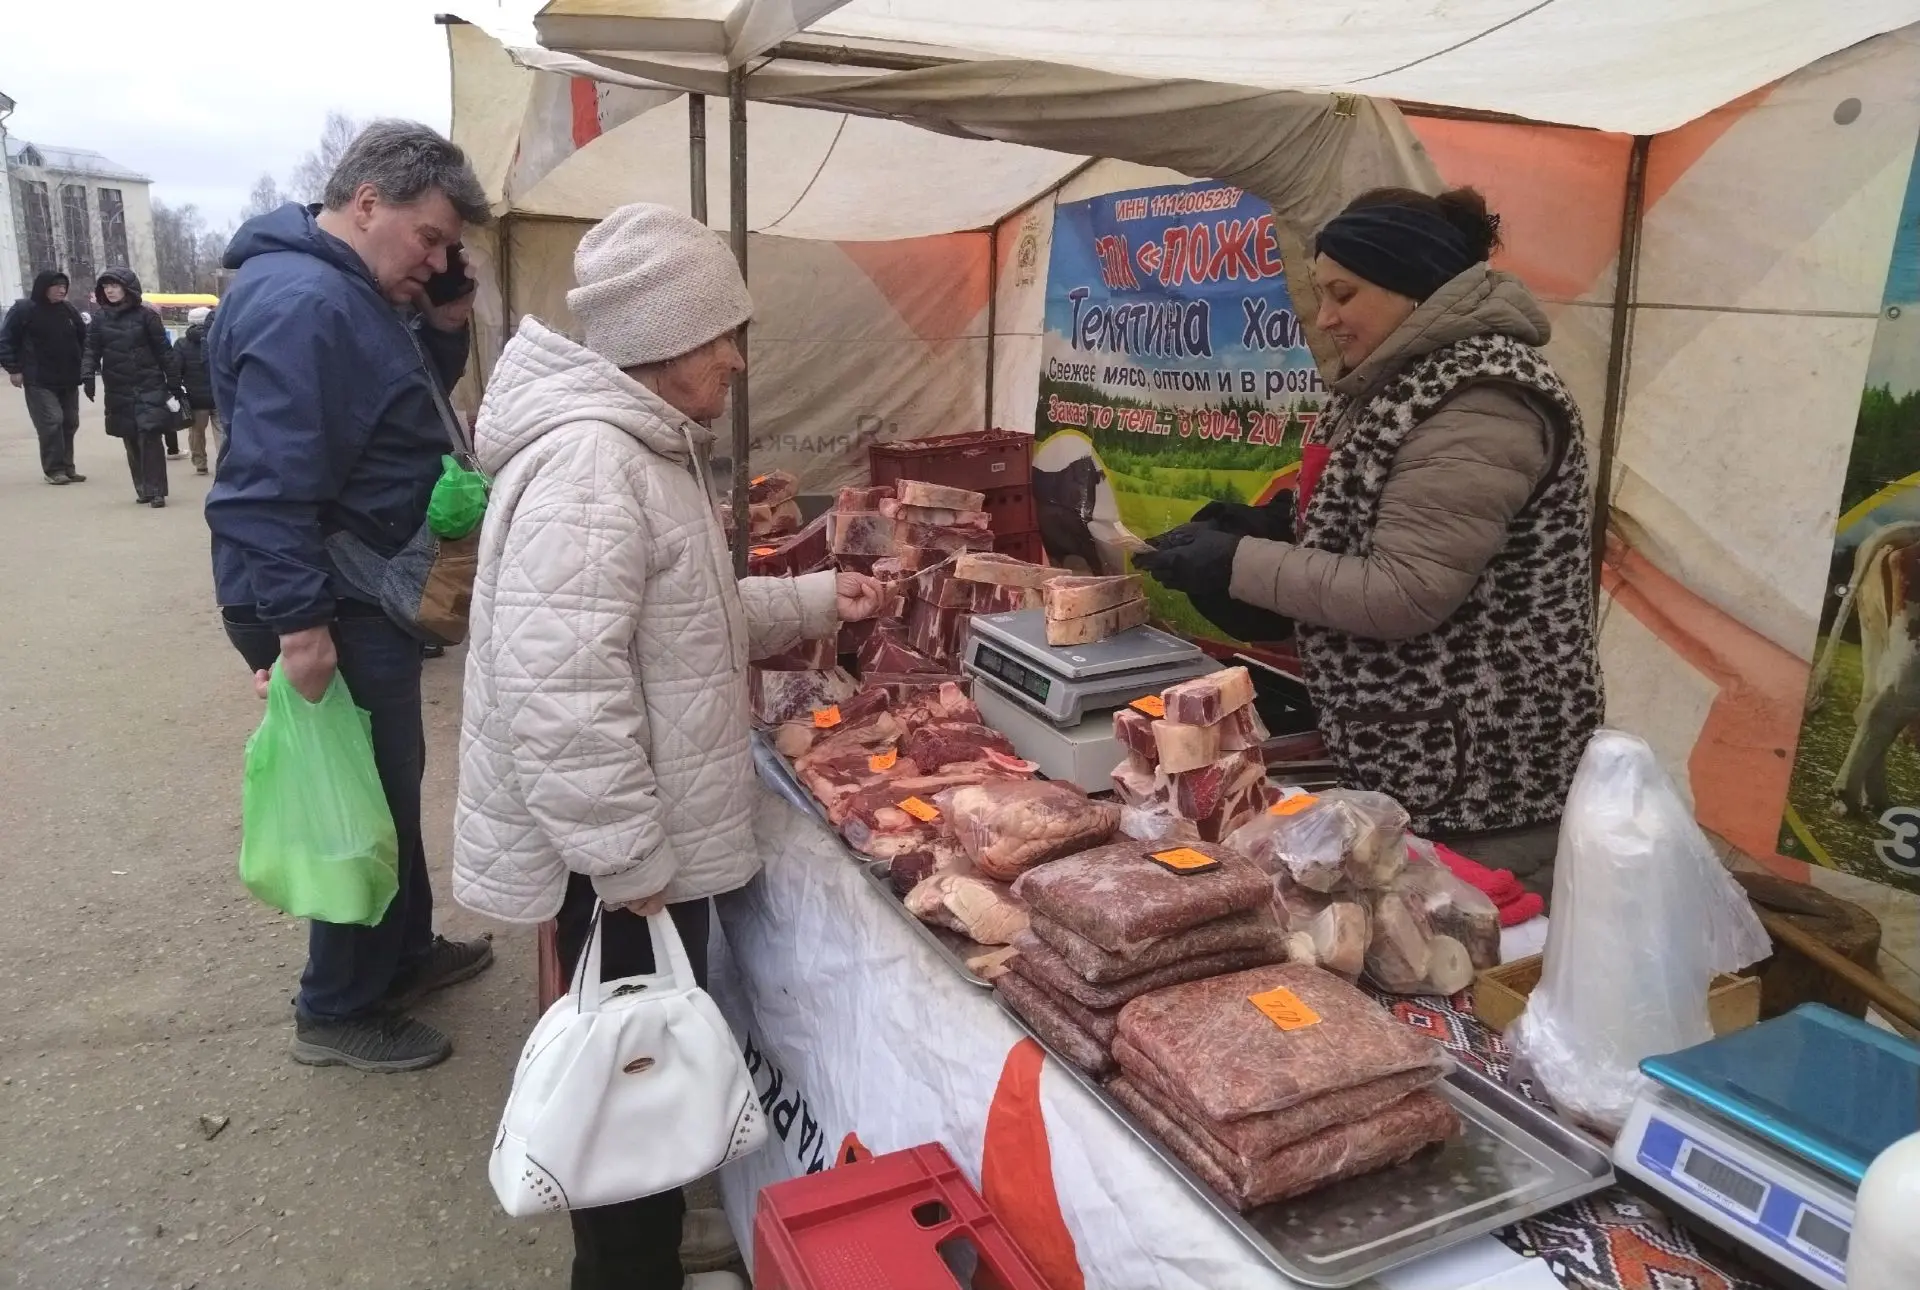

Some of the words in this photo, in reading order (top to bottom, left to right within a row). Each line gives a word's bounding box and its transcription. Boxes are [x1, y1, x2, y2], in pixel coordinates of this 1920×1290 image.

[1115, 197, 1148, 221] ИНН
[1069, 286, 1213, 359] Телятина
[1049, 357, 1096, 382] Свежее
[1153, 370, 1211, 393] оптом
[1217, 370, 1233, 393] и
[1240, 370, 1256, 393] в
[1048, 394, 1088, 427] Заказ
[1196, 409, 1243, 443] 904
